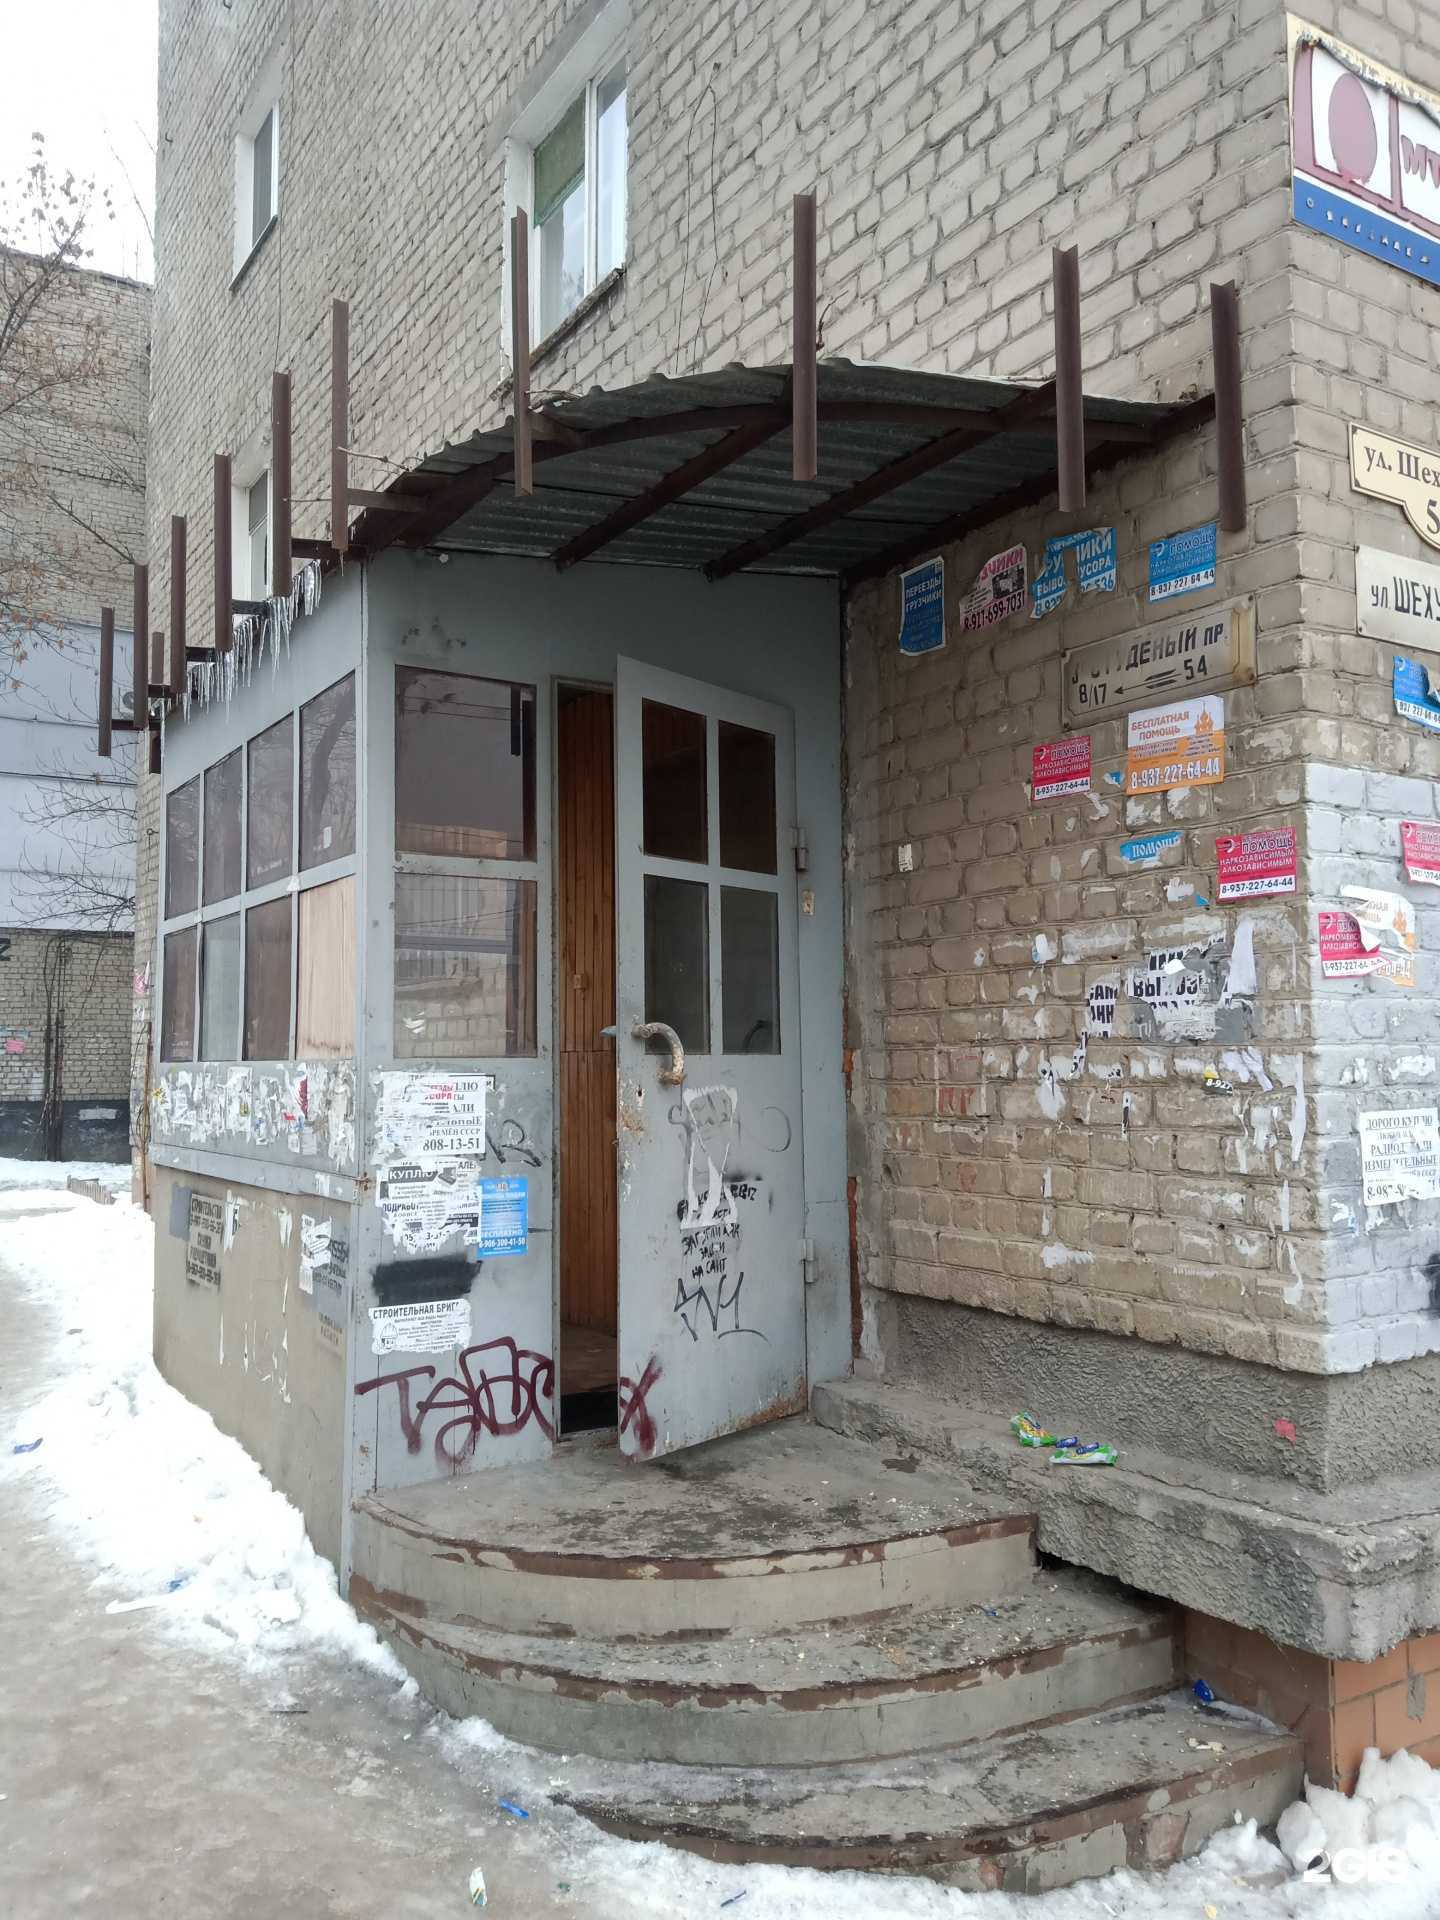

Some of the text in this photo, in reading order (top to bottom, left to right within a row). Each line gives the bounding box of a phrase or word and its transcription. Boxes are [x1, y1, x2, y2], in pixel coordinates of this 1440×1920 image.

[1364, 446, 1392, 473] ул.
[1080, 555, 1112, 579] УСОРА
[905, 576, 941, 599] ПЕРЕЕЗДЫ
[905, 590, 942, 612] ГРУЗЧИКИ
[1184, 655, 1208, 680] 54
[1131, 711, 1190, 731] БЕСПЛАТНАЯ
[1139, 725, 1181, 741] ПОМОЩЬ
[1131, 757, 1220, 790] 8-937-227-64-44
[1035, 778, 1089, 796] 8-937-227-64-44
[1242, 839, 1294, 855] ПОМОЩЬ
[1220, 848, 1295, 866] НАРКОЗАВИСИМЫМ
[1222, 858, 1293, 874] АЛКОЗАВИСИМЫМ
[1222, 877, 1293, 894] 8-937-227-64-44
[422, 1137, 480, 1152] 808-13-51
[373, 1304, 434, 1319] СТРОИТЕЛЬНАЯ
[436, 1301, 459, 1313] БРИГ
